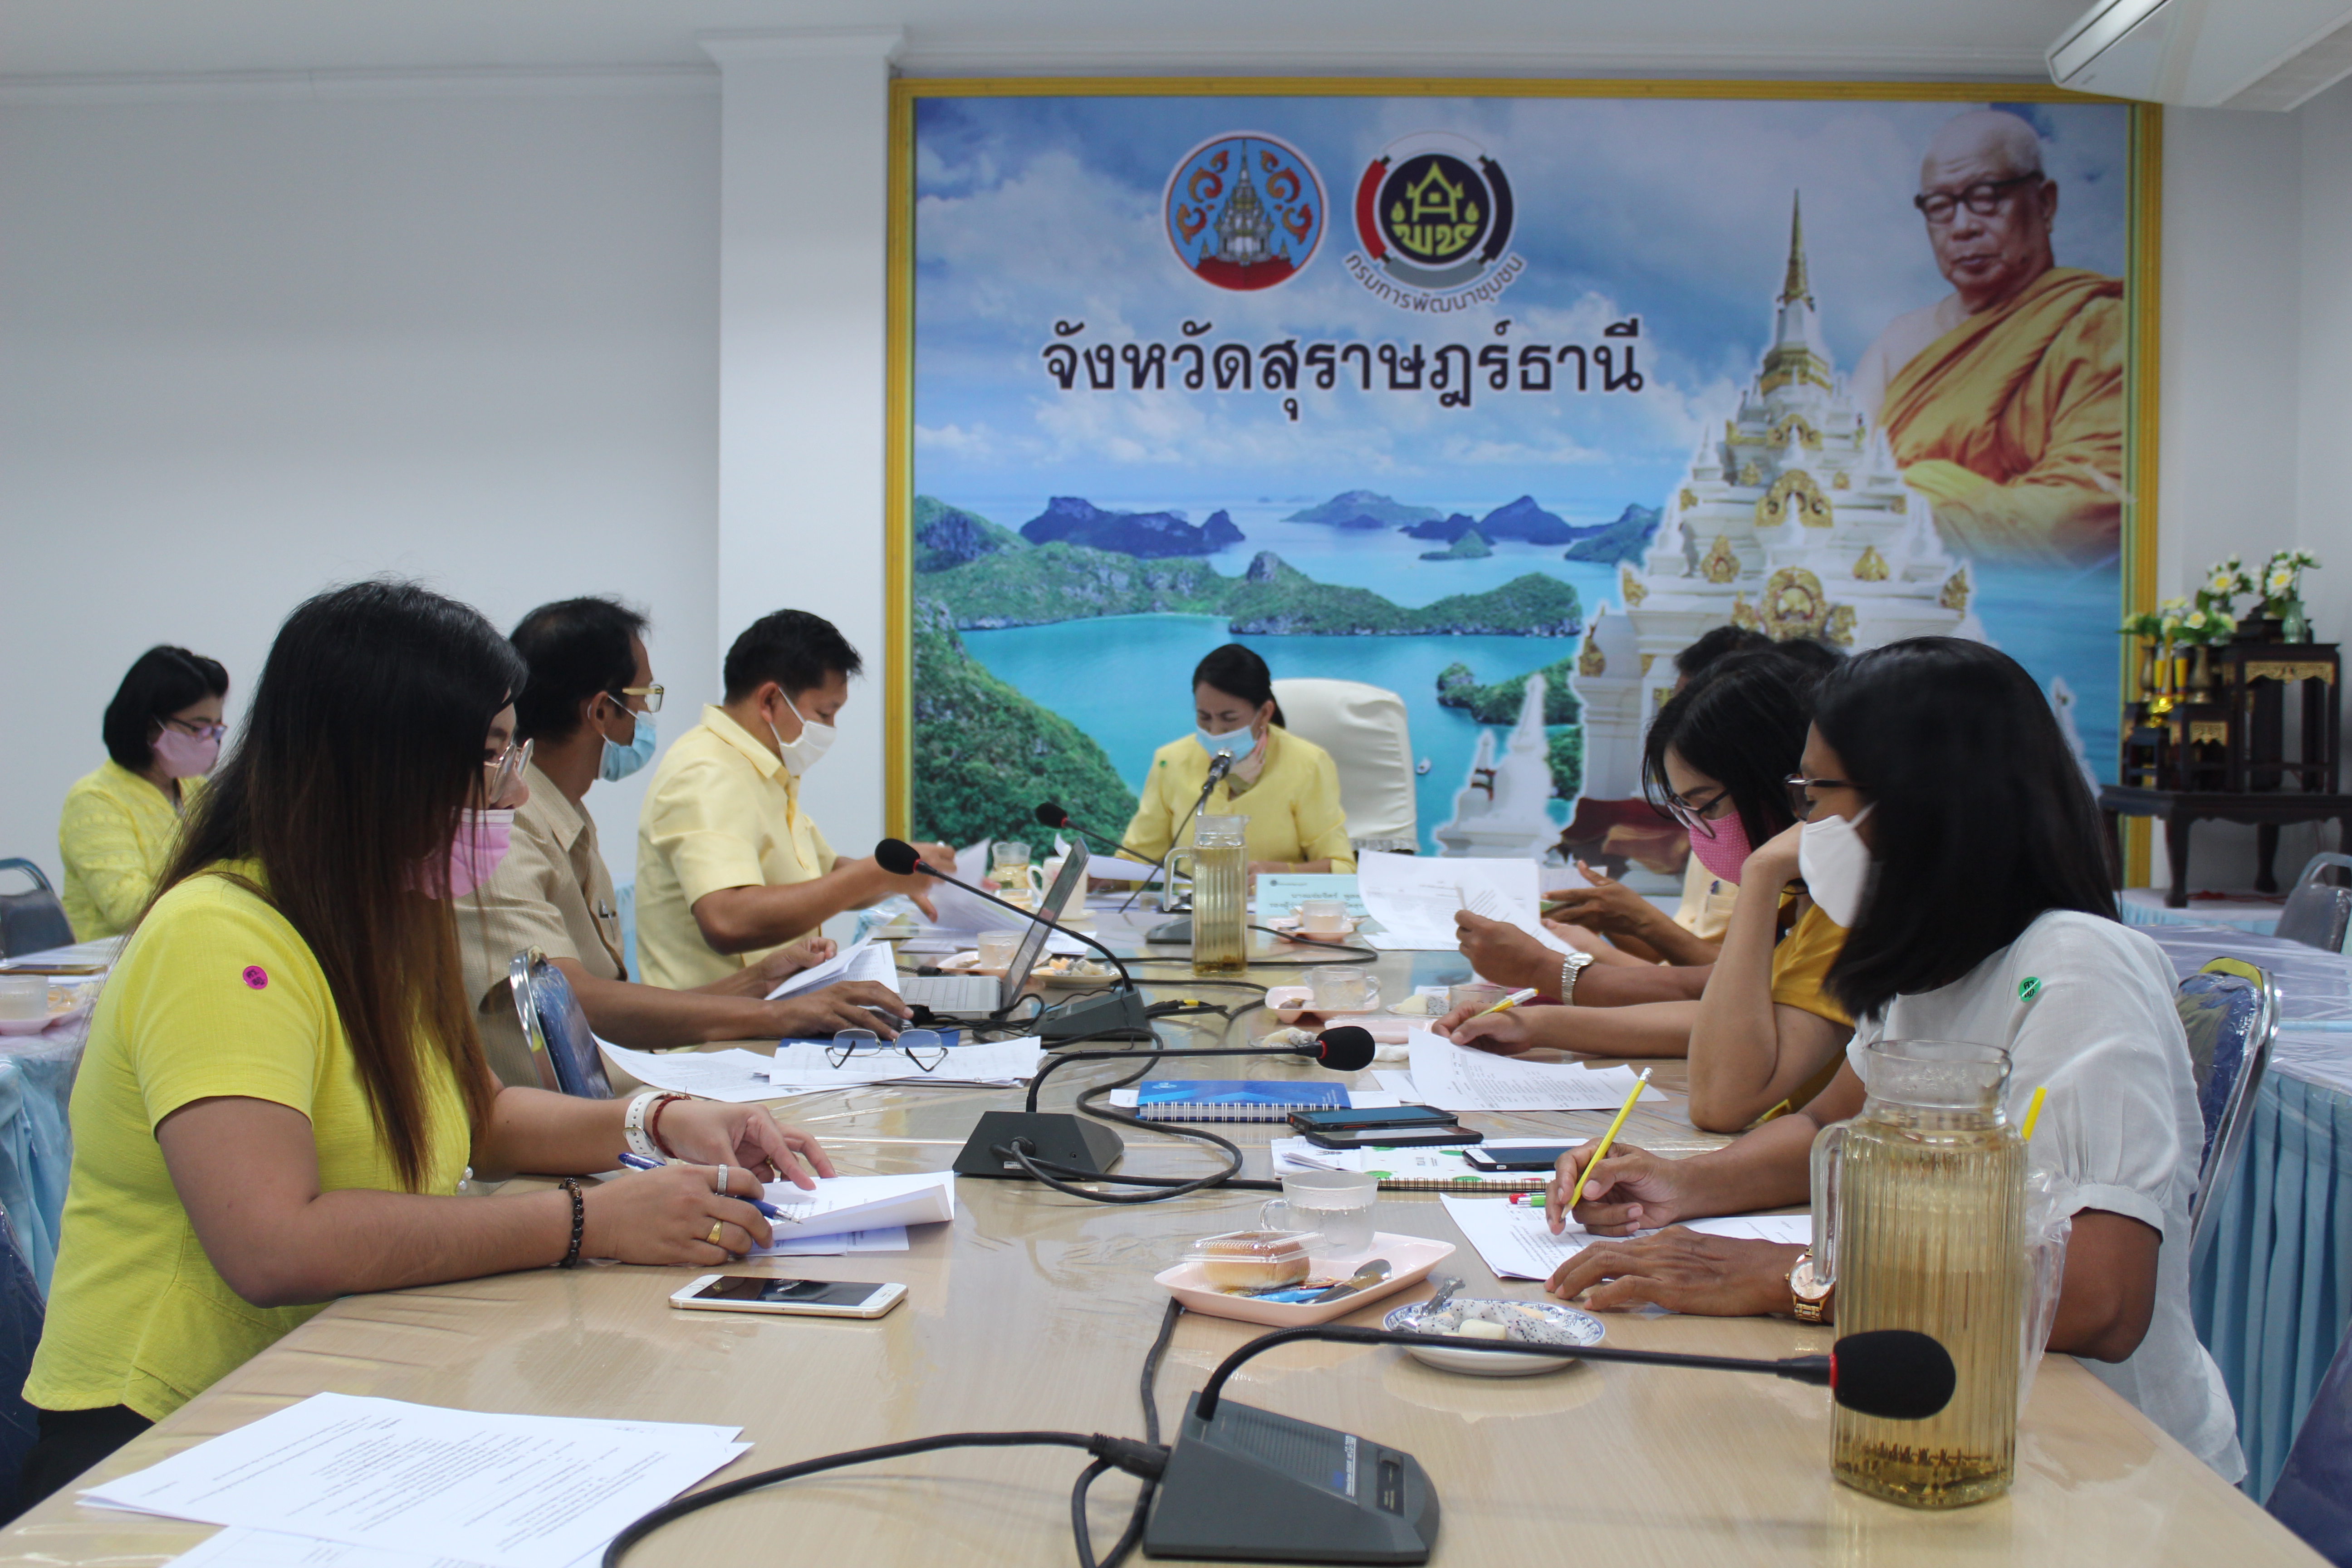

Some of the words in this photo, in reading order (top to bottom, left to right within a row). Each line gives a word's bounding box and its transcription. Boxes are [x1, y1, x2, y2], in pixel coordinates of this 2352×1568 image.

[1345, 255, 1524, 313] กรมการพัฒนาชุมชน
[1043, 318, 1643, 421] จังหวัดสุราษฎร์ธานี
